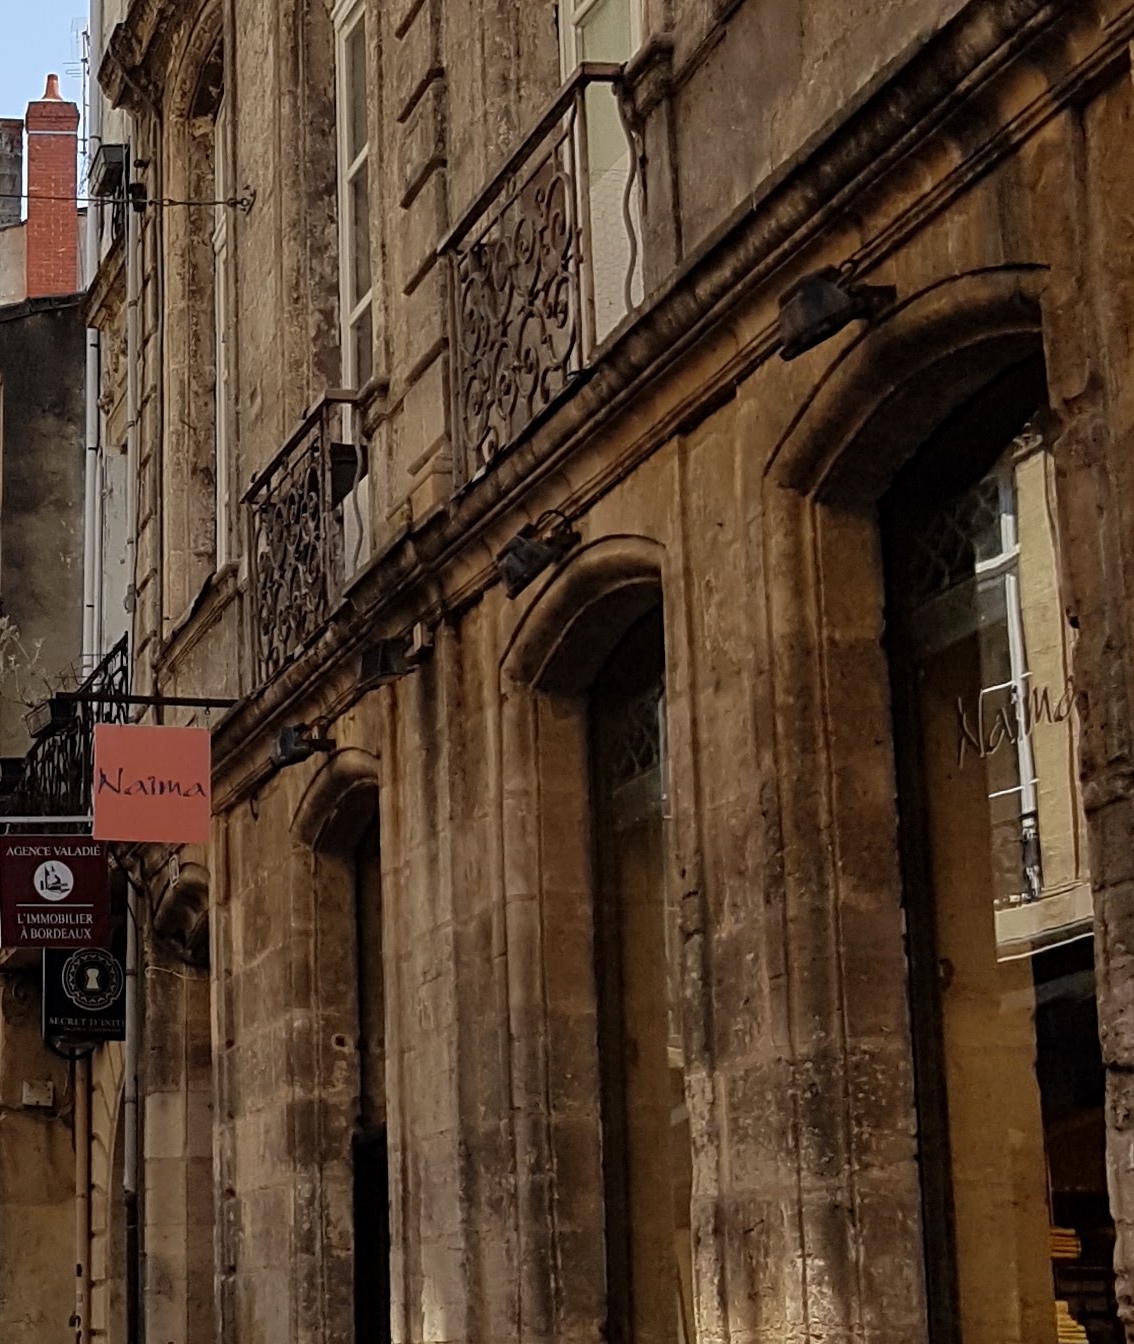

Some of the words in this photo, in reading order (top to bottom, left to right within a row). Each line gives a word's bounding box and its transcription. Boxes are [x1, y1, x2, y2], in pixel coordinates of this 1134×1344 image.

[6, 846, 52, 856] AGENCE
[53, 844, 101, 856] VALADIÉ
[17, 912, 94, 925] L'IMMOBILIER
[20, 925, 28, 939] À
[30, 927, 92, 939] BORDEAUX
[49, 1017, 87, 1026] SECRET
